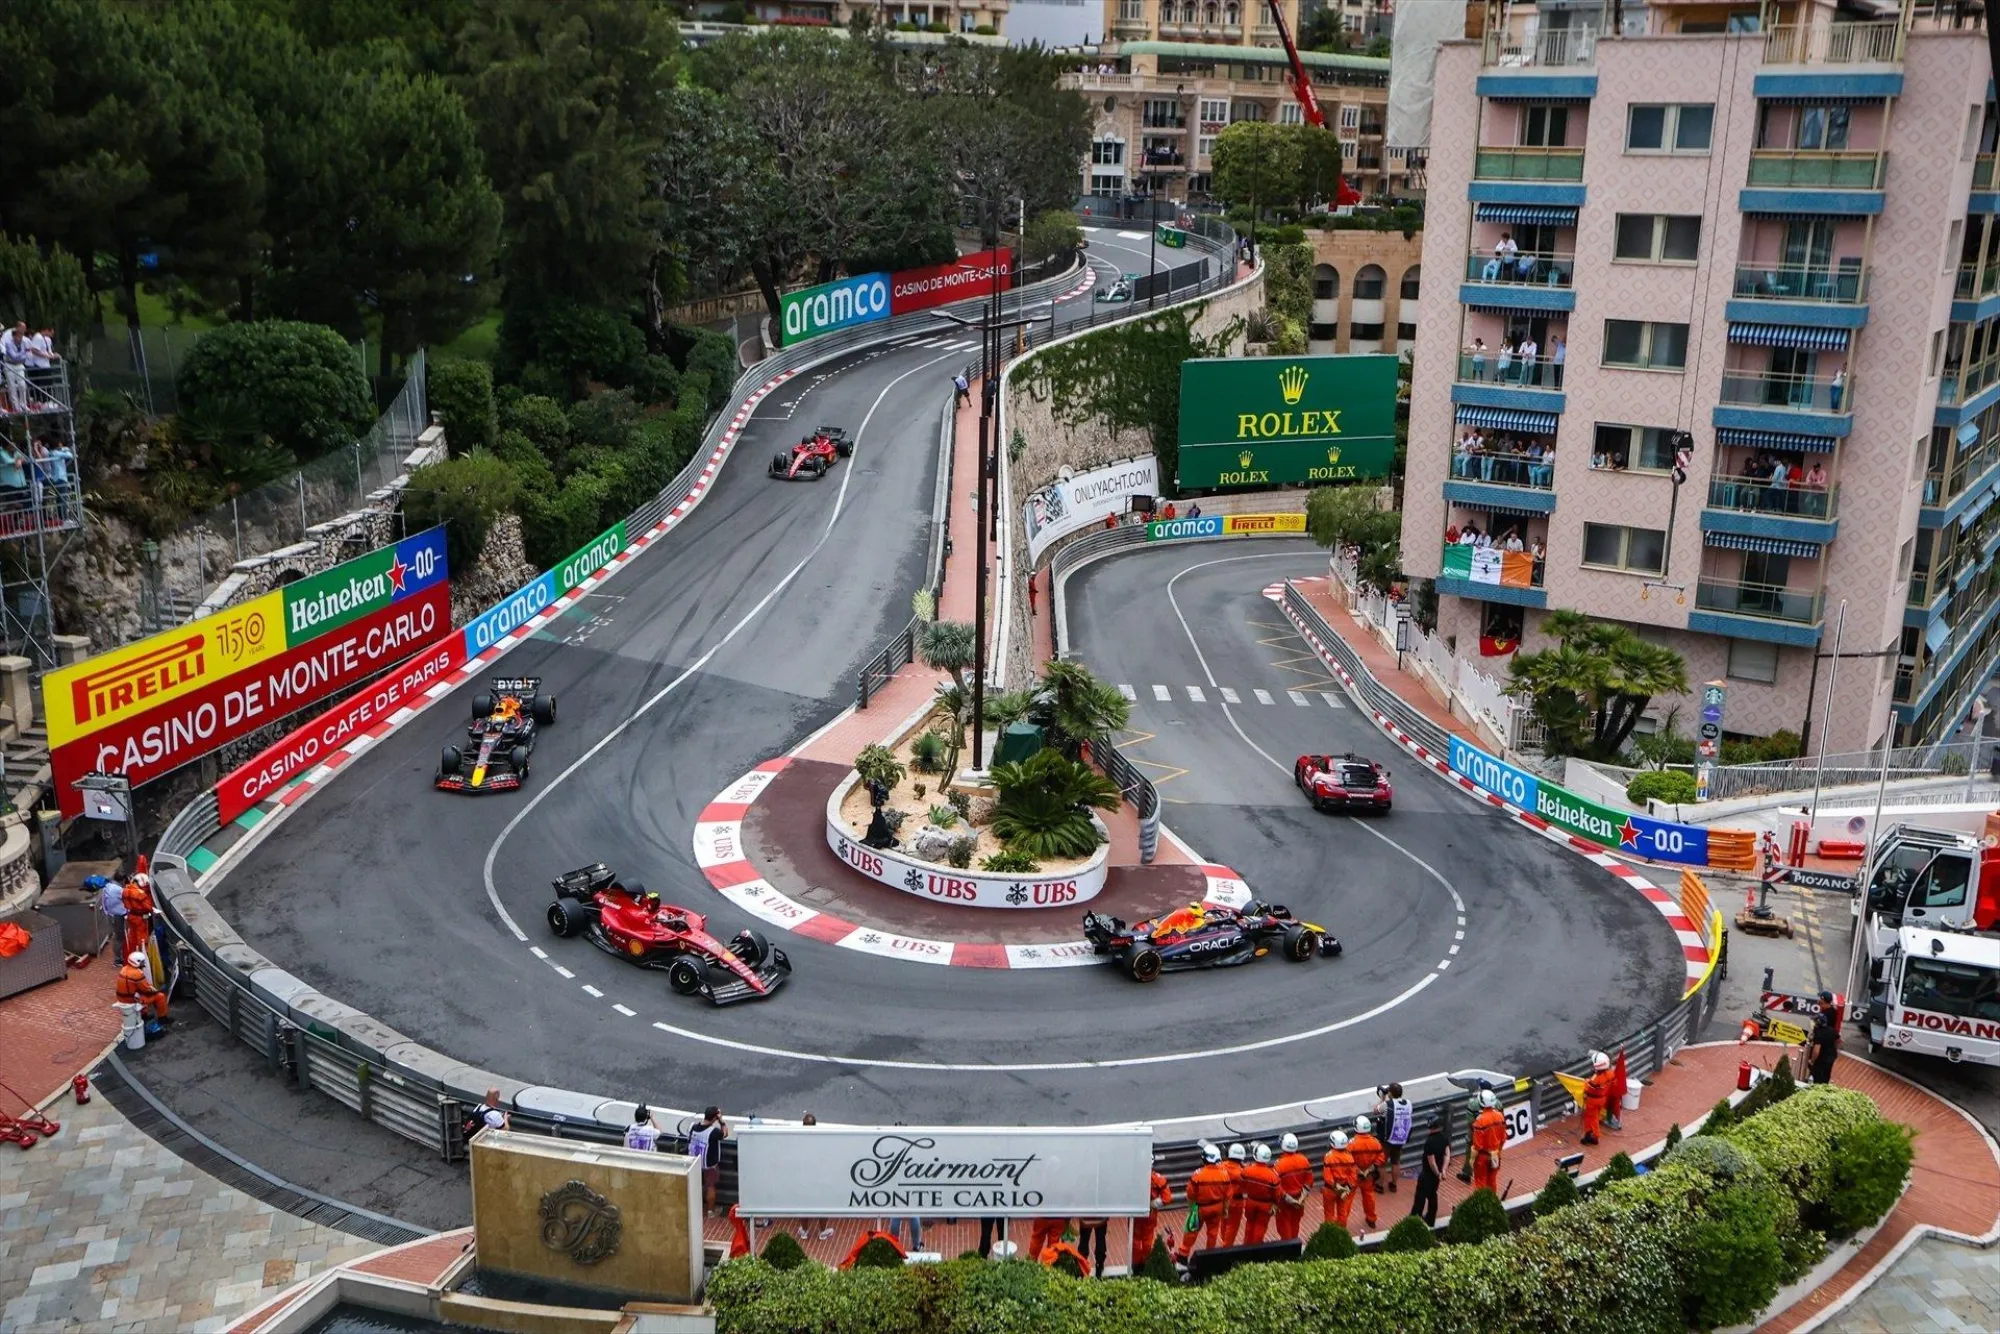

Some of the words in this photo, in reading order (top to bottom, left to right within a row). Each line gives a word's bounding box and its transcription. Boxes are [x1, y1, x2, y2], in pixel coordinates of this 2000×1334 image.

[894, 279, 930, 298] CASINO
[930, 274, 943, 289] DE
[786, 280, 887, 336] aramco
[1237, 410, 1342, 438] ROLEX
[1074, 468, 1152, 504] ONLYYACHT.COM
[1219, 470, 1269, 485] ROLEX
[1308, 466, 1356, 479] ROLEX
[1154, 519, 1216, 538] aramco
[1231, 516, 1276, 530] PIRELLI
[563, 533, 619, 589] aramco
[290, 574, 386, 634] Heineken
[476, 583, 547, 648] aramco
[71, 633, 206, 726] PIRELLI
[96, 703, 217, 776] CASINO
[224, 680, 264, 728] DE
[268, 602, 435, 708] MONTE-CARLO
[243, 737, 318, 799] CASINO
[322, 703, 372, 745] CAFE
[375, 687, 400, 712] DE
[403, 651, 450, 694] PARIS
[1456, 745, 1525, 803] aramco
[730, 783, 758, 801] UBS
[1537, 789, 1613, 839] Heineken
[713, 837, 735, 859] UBS
[849, 846, 884, 877] UBS
[928, 874, 977, 901] UBS
[1032, 880, 1077, 905] UBS
[1791, 871, 1851, 890] PIOVANO
[762, 896, 799, 919] UBS
[890, 938, 942, 955] UBS
[1504, 1108, 1529, 1140] SC
[850, 1135, 1042, 1189] Fairmont
[848, 1190, 943, 1208] MONTE
[953, 1190, 1044, 1208] CARLO
